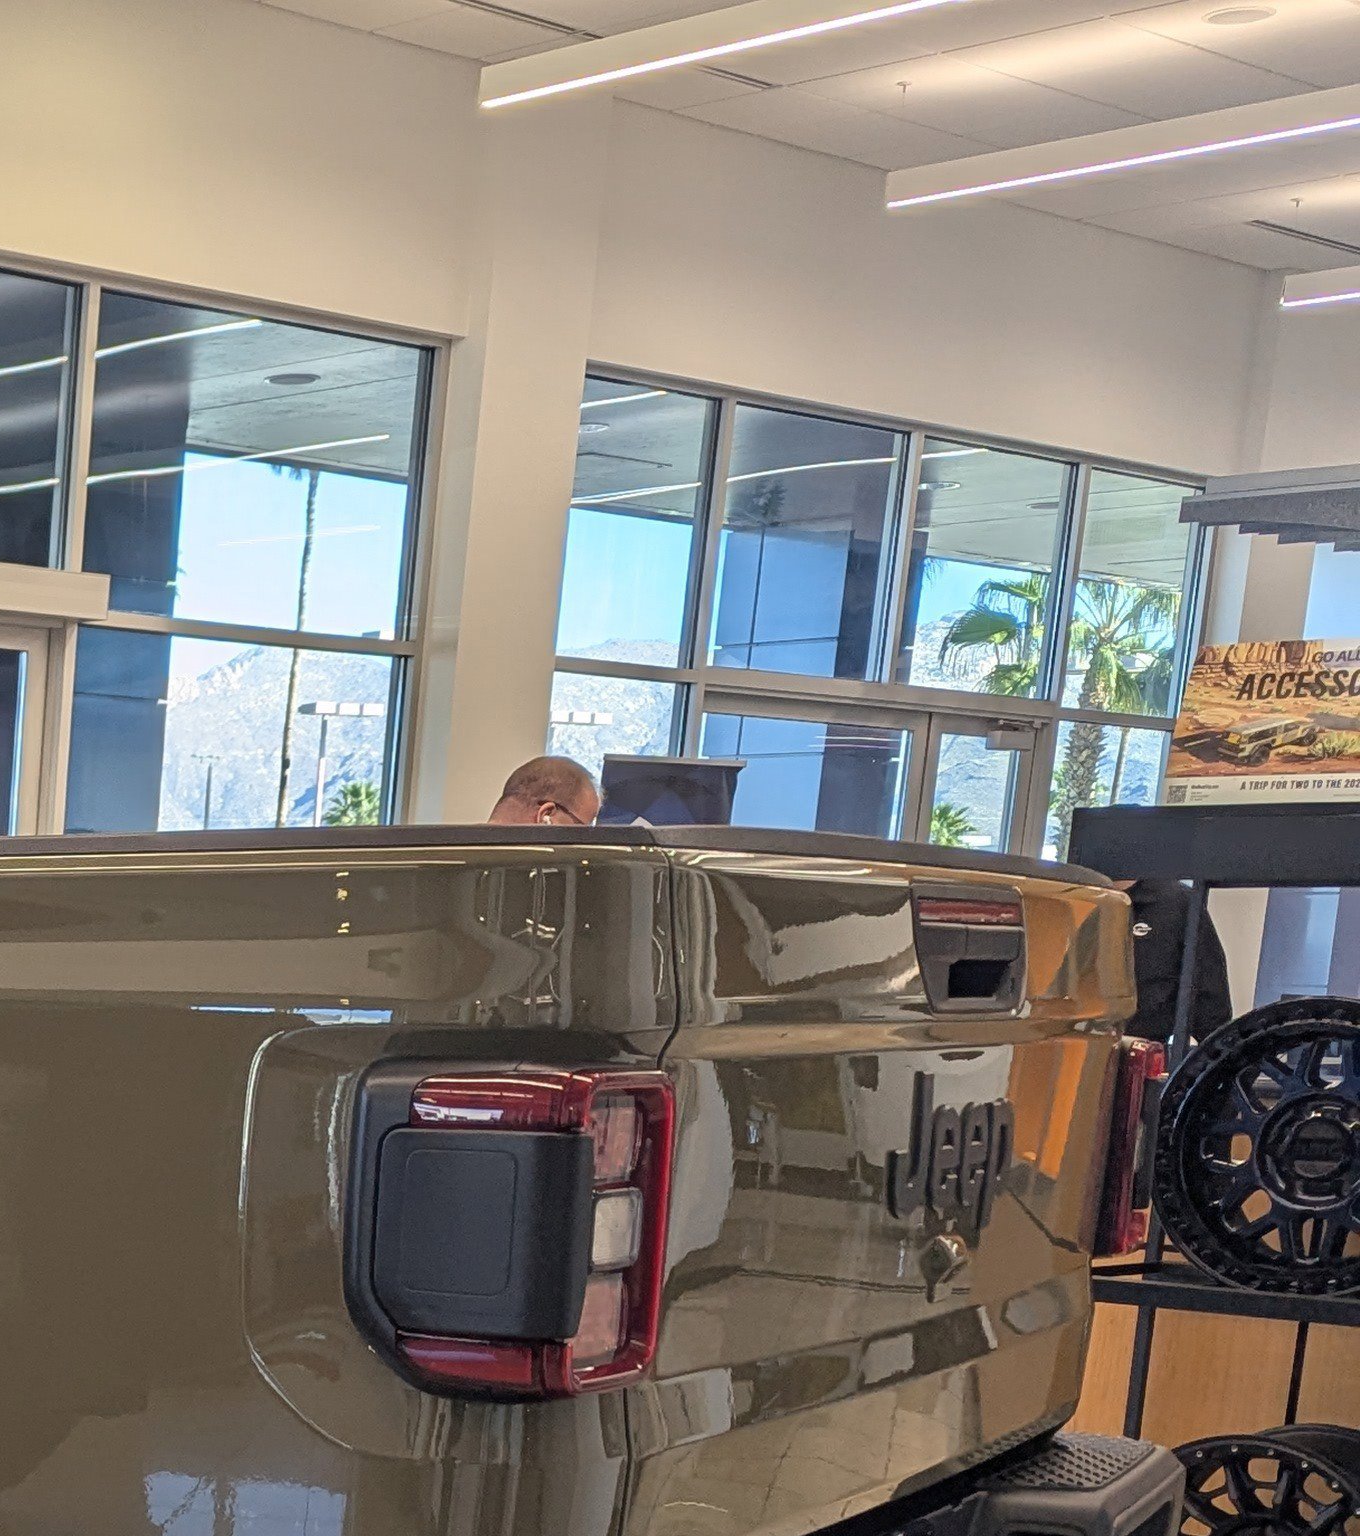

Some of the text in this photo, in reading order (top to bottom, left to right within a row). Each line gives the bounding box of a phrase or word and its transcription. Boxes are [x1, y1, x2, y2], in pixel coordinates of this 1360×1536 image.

[1311, 651, 1335, 663] GO
[1249, 781, 1269, 790] TRIP
[1270, 781, 1288, 789] FOR
[1291, 780, 1310, 789] TWO
[1312, 780, 1324, 789] TO
[1326, 780, 1342, 788] THE
[885, 1070, 1015, 1232] Jeep
